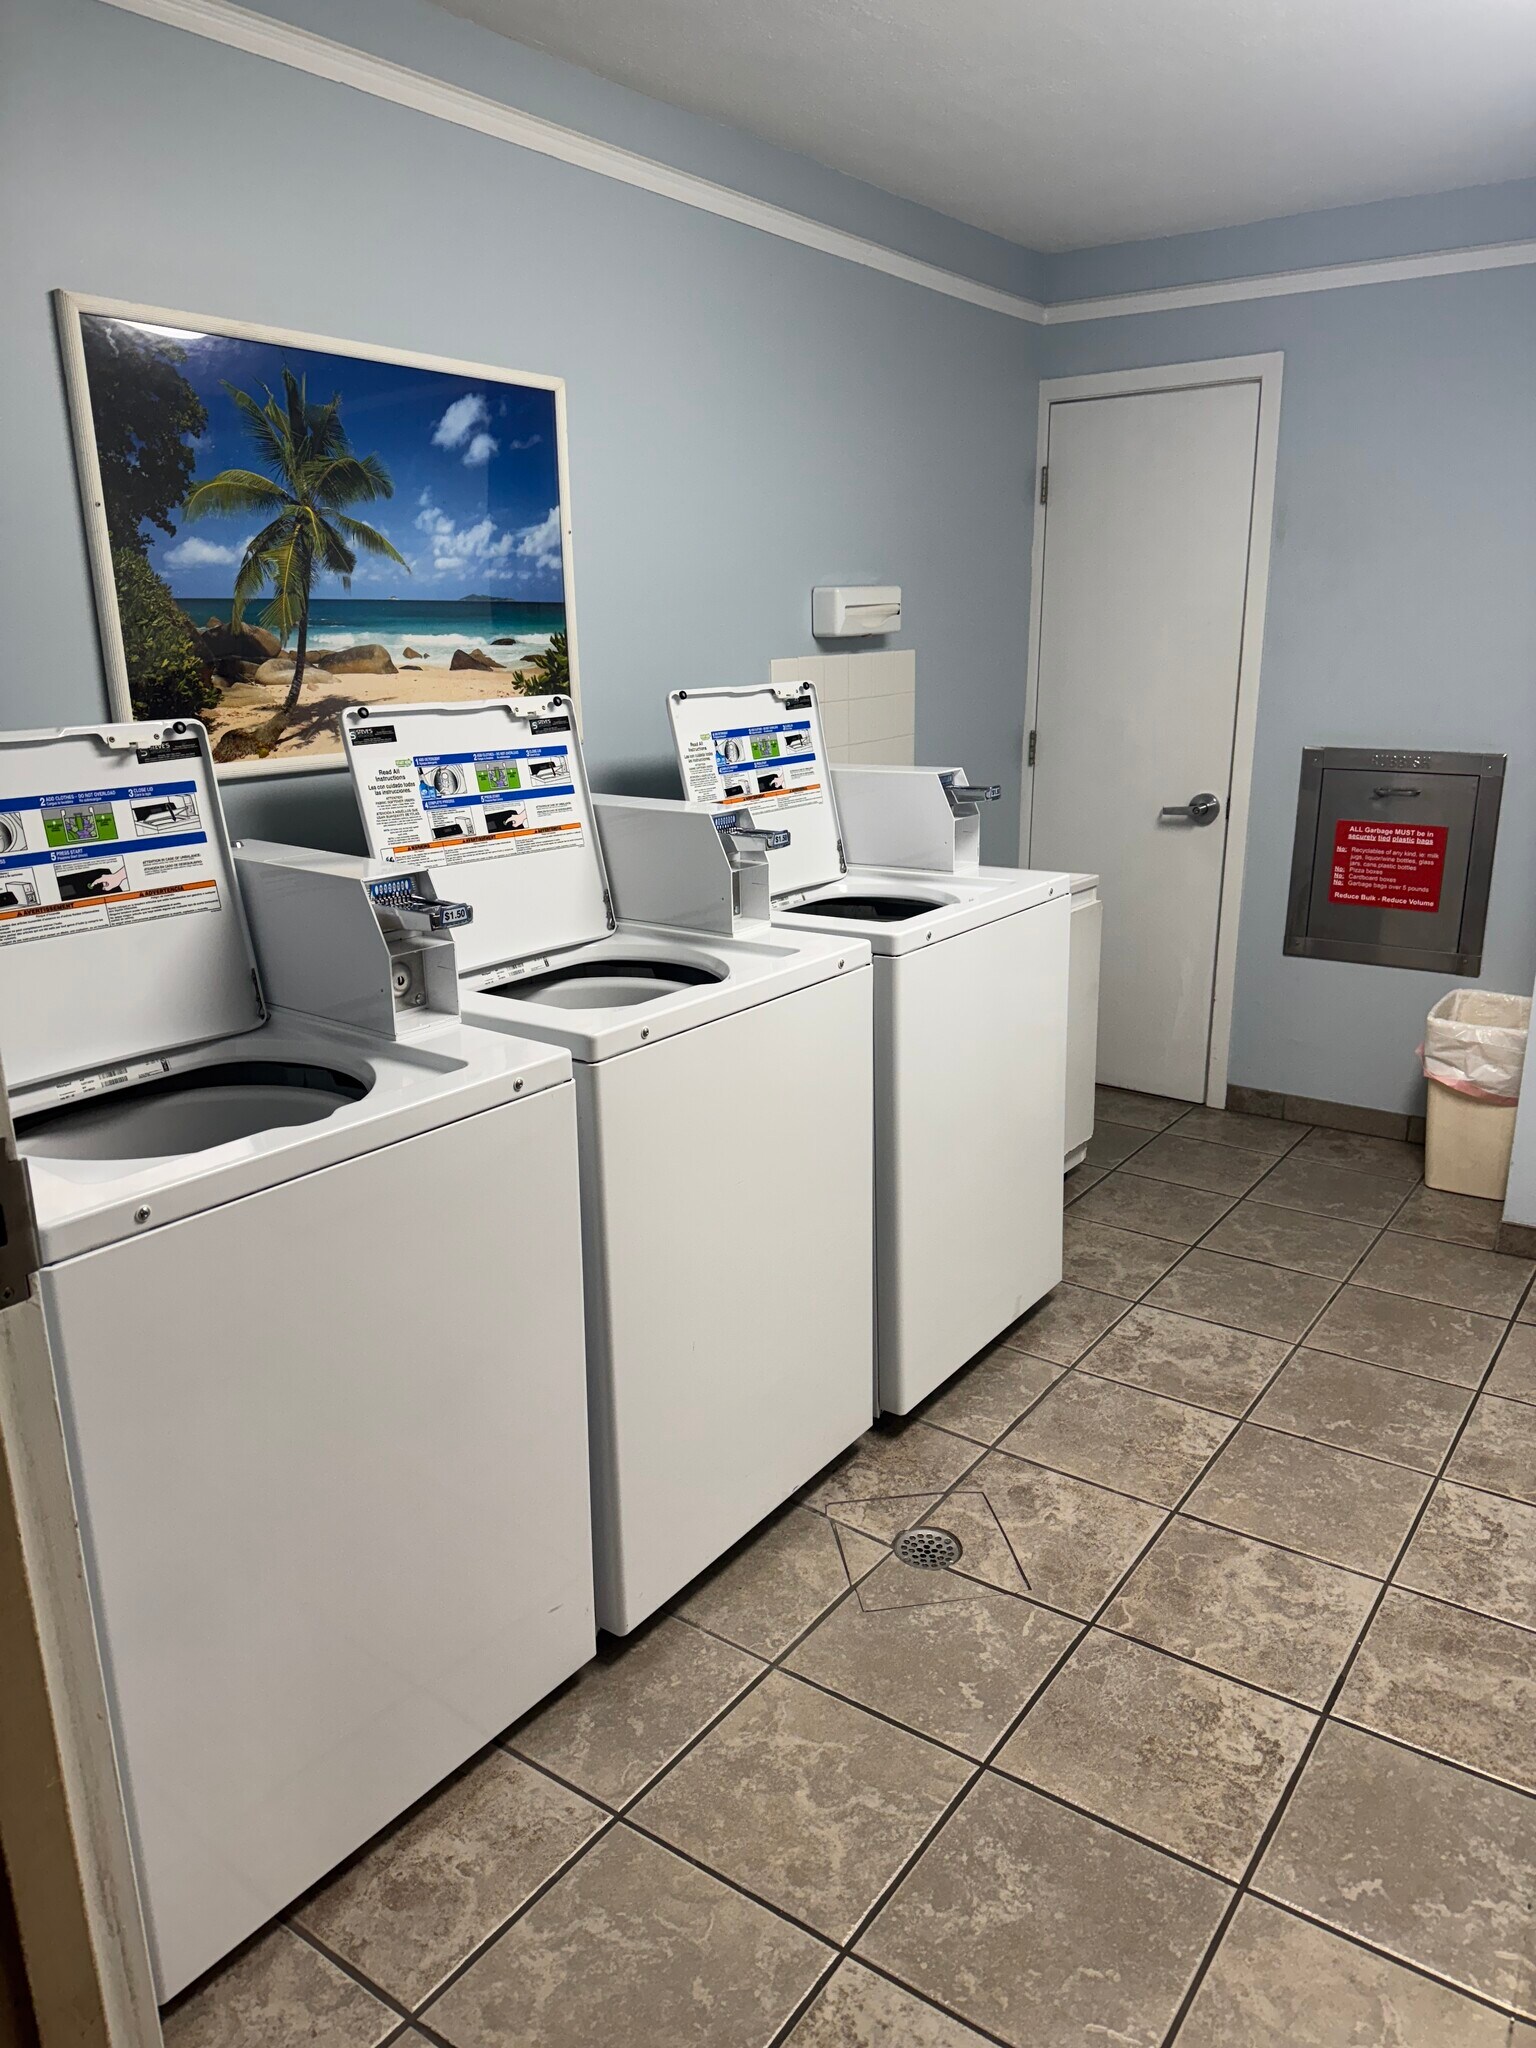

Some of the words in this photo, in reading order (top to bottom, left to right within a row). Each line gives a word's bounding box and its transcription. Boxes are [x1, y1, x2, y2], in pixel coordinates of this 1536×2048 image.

[128, 788, 133, 797] 3
[40, 797, 46, 806] 2
[1365, 827, 1393, 835] Garbage
[50, 852, 56, 860] 5
[145, 885, 184, 897] ADVERTENCIA
[1382, 896, 1407, 904] Reduce
[1409, 899, 1434, 907] Volume
[23, 903, 74, 915] AVERTISSEMENT
[445, 909, 465, 921] $1.50
